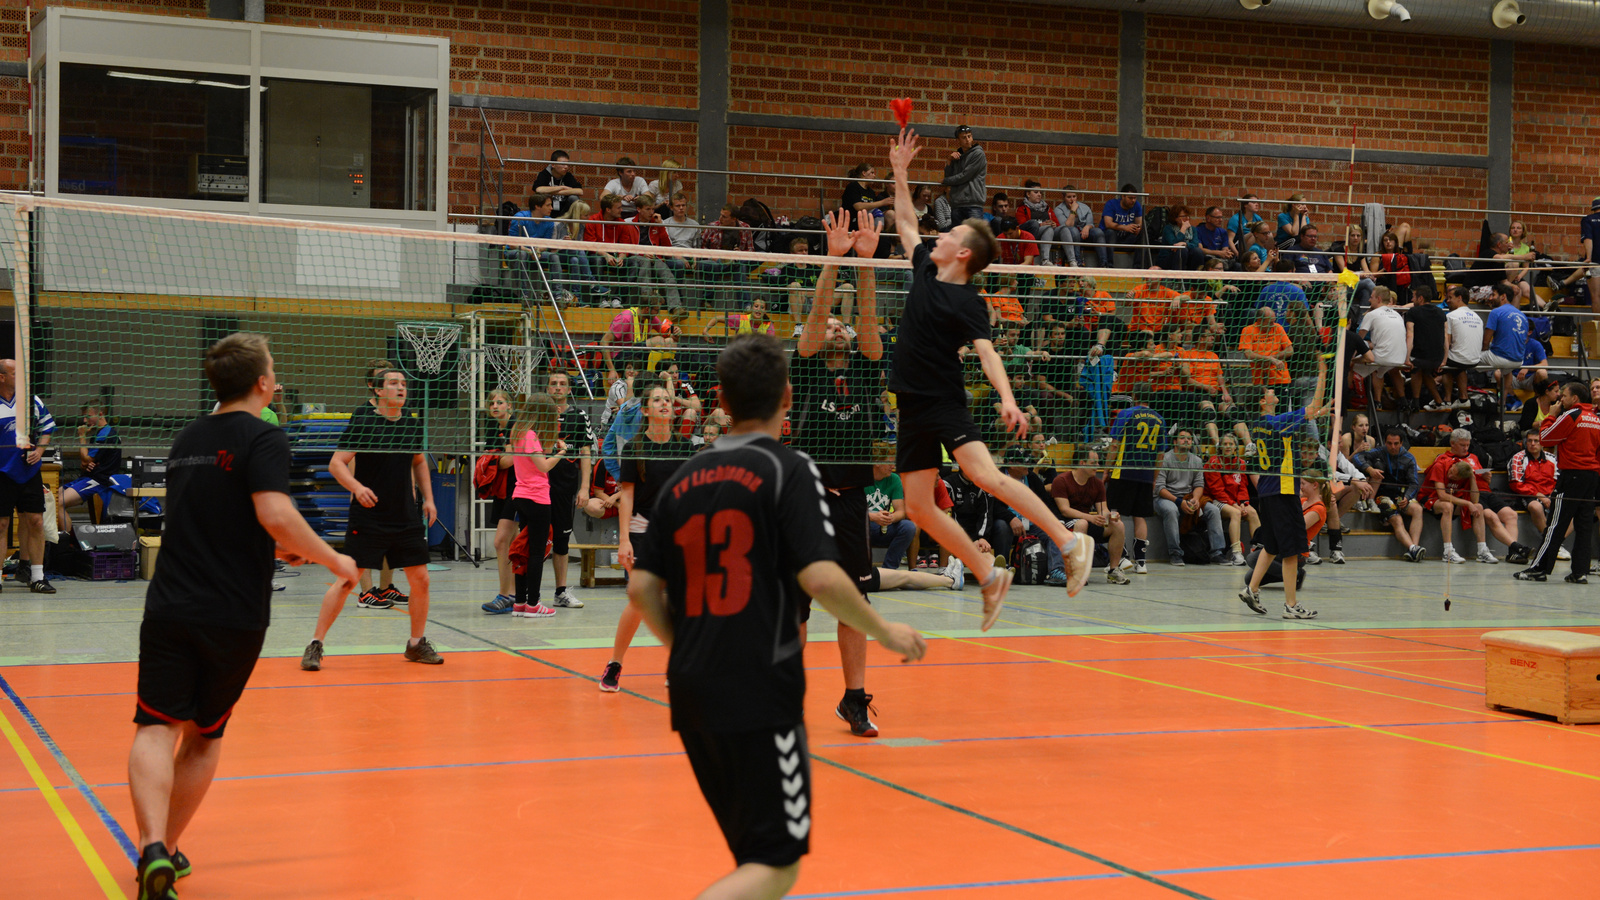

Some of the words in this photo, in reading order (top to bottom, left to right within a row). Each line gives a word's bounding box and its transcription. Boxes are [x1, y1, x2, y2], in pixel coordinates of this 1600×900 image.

[821, 399, 836, 412] LS
[780, 420, 791, 436] 8
[1136, 421, 1161, 451] 24
[1256, 438, 1271, 470] 8
[672, 477, 690, 499] TV
[673, 509, 754, 617] 13
[1510, 657, 1537, 669] BENZ
